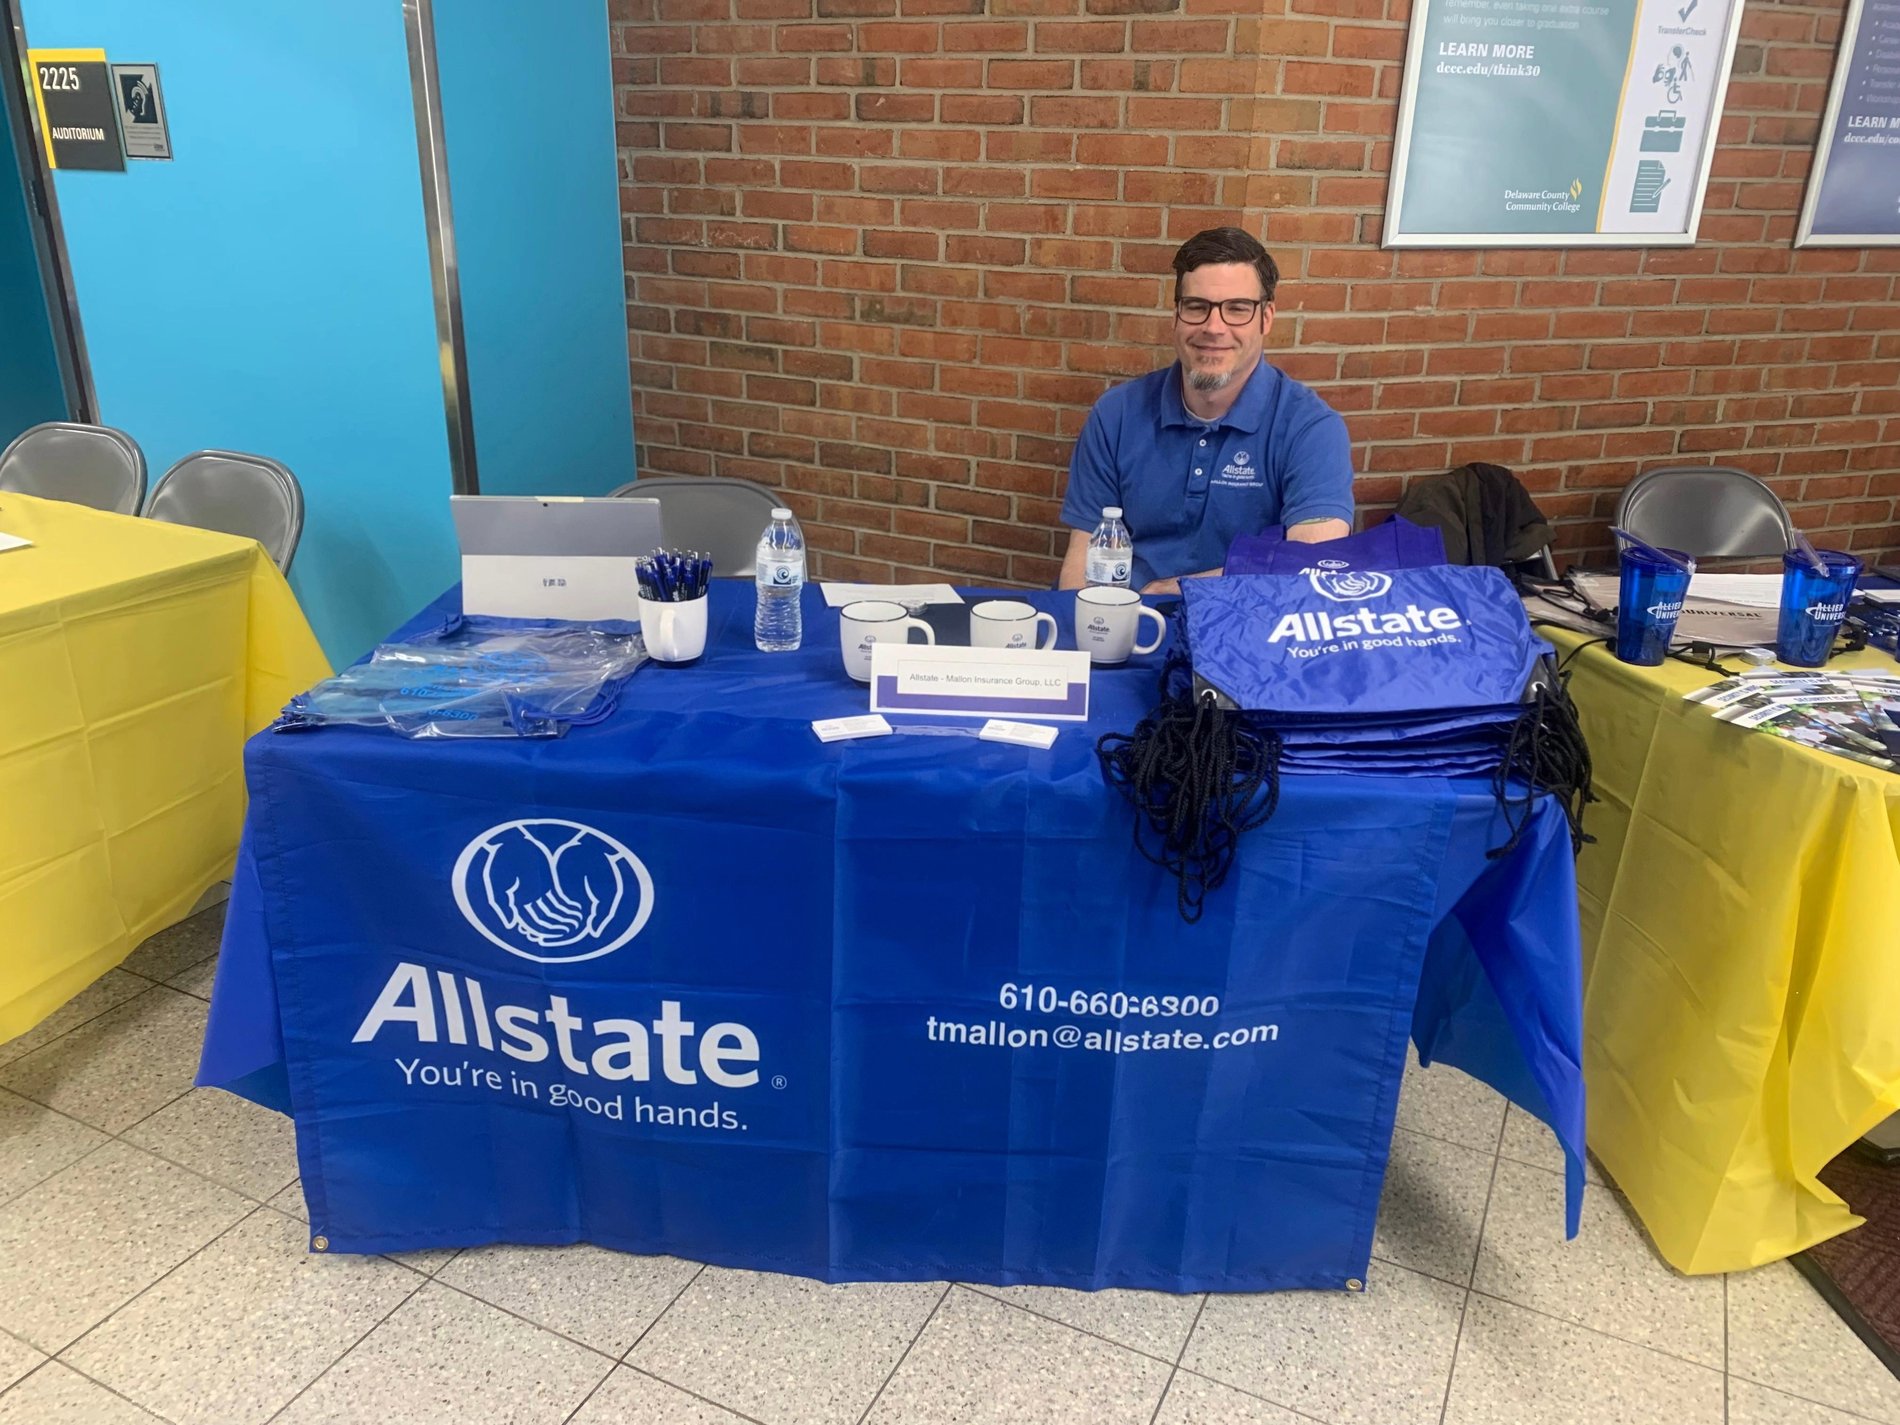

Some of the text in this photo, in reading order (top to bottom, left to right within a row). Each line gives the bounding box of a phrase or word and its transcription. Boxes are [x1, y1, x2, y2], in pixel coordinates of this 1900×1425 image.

[1439, 42, 1535, 58] LEARN MORE
[1436, 61, 1540, 77] dccc.edu/think30
[40, 67, 79, 90] 2225
[1848, 116, 1900, 128] LEARN M
[52, 127, 104, 140] AUDITORIUM
[1844, 132, 1900, 146] dccc.edu/co
[1504, 190, 1569, 201] Delaware County
[1505, 202, 1580, 213] Community College
[1222, 465, 1255, 475] Allstate
[1816, 602, 1844, 612] ALLIED
[1267, 604, 1462, 643] Allstate
[1287, 632, 1462, 658] You're in good hands.
[909, 673, 939, 682] Allstate
[946, 674, 972, 683] Mallon
[974, 676, 1013, 685] Insurance
[1015, 678, 1043, 687] Group,
[1044, 679, 1062, 687] LLC
[999, 982, 1220, 1019] 610-660-6300
[351, 962, 761, 1088] Allstate
[926, 1015, 1280, 1055] tmallon@allstate.com
[395, 1058, 749, 1131] You're in good hands.
